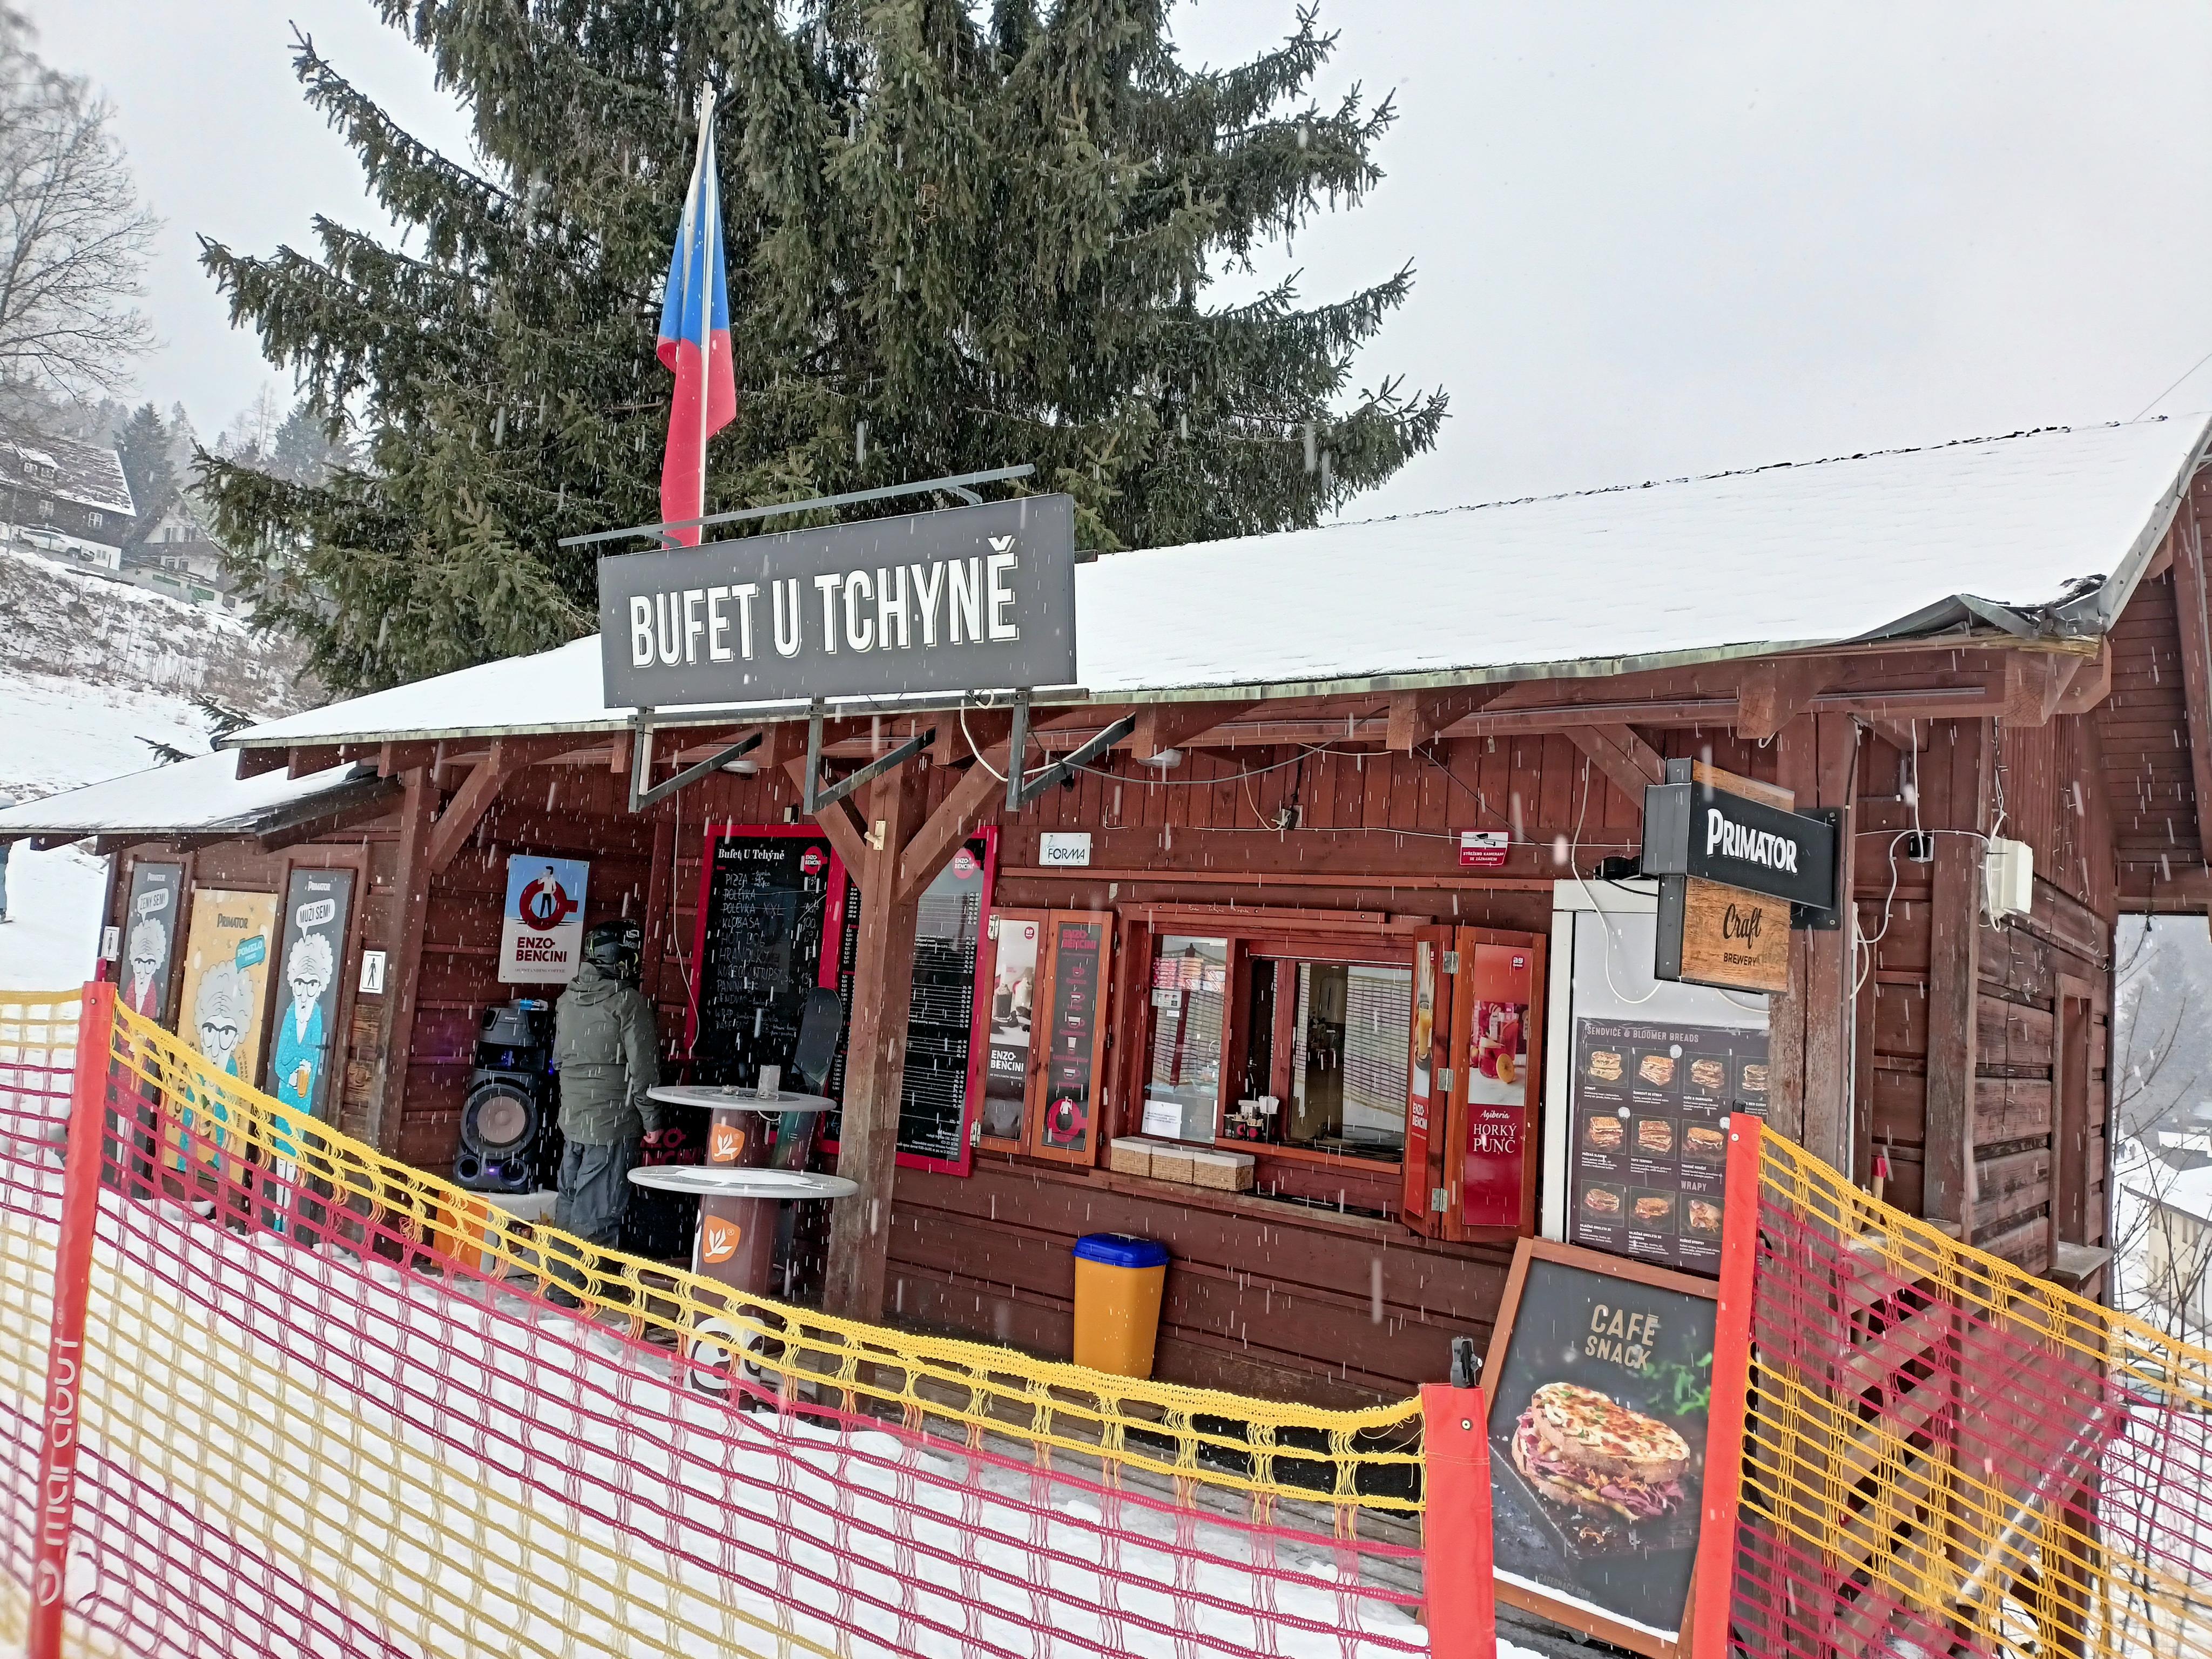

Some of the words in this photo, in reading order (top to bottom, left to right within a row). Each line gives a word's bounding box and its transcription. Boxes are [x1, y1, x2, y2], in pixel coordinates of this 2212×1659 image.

[629, 583, 759, 669] BUFET
[772, 578, 802, 659] U
[813, 535, 1020, 655] TCHYNĚ
[1707, 808, 1798, 875] PRIMATOR
[744, 849, 751, 859] U
[752, 849, 785, 861] Tchýně
[1048, 848, 1085, 860] FORMA
[725, 873, 748, 886] PIZZA
[308, 881, 331, 892] PRIMATOR
[299, 905, 315, 923] MUŽI
[315, 903, 331, 920] SEM!
[217, 913, 248, 929] PRIMATOR
[1723, 902, 1762, 949] Craft
[1062, 929, 1088, 939] ENZO
[237, 941, 262, 957] POMELO
[517, 936, 555, 949] ENZO
[1062, 939, 1097, 949] BENCINI
[516, 949, 567, 962] BENCINI
[1723, 952, 1757, 967] BREWERY
[1633, 1030, 1667, 1041] BLOOMER
[1669, 1032, 1699, 1043] BREADS
[991, 1049, 1016, 1061] ENZO
[990, 1059, 1024, 1073] BENCINI
[1413, 1101, 1424, 1116] ENZO
[1480, 1110, 1510, 1121] Agiberia
[1412, 1115, 1427, 1130] BENCINI
[1473, 1123, 1518, 1136] HORKÝ
[1473, 1136, 1516, 1154] PUNČ
[1681, 1180, 1707, 1192] WRAPY
[1584, 1335, 1651, 1371] SNACK
[43, 1335, 79, 1546] marabut
